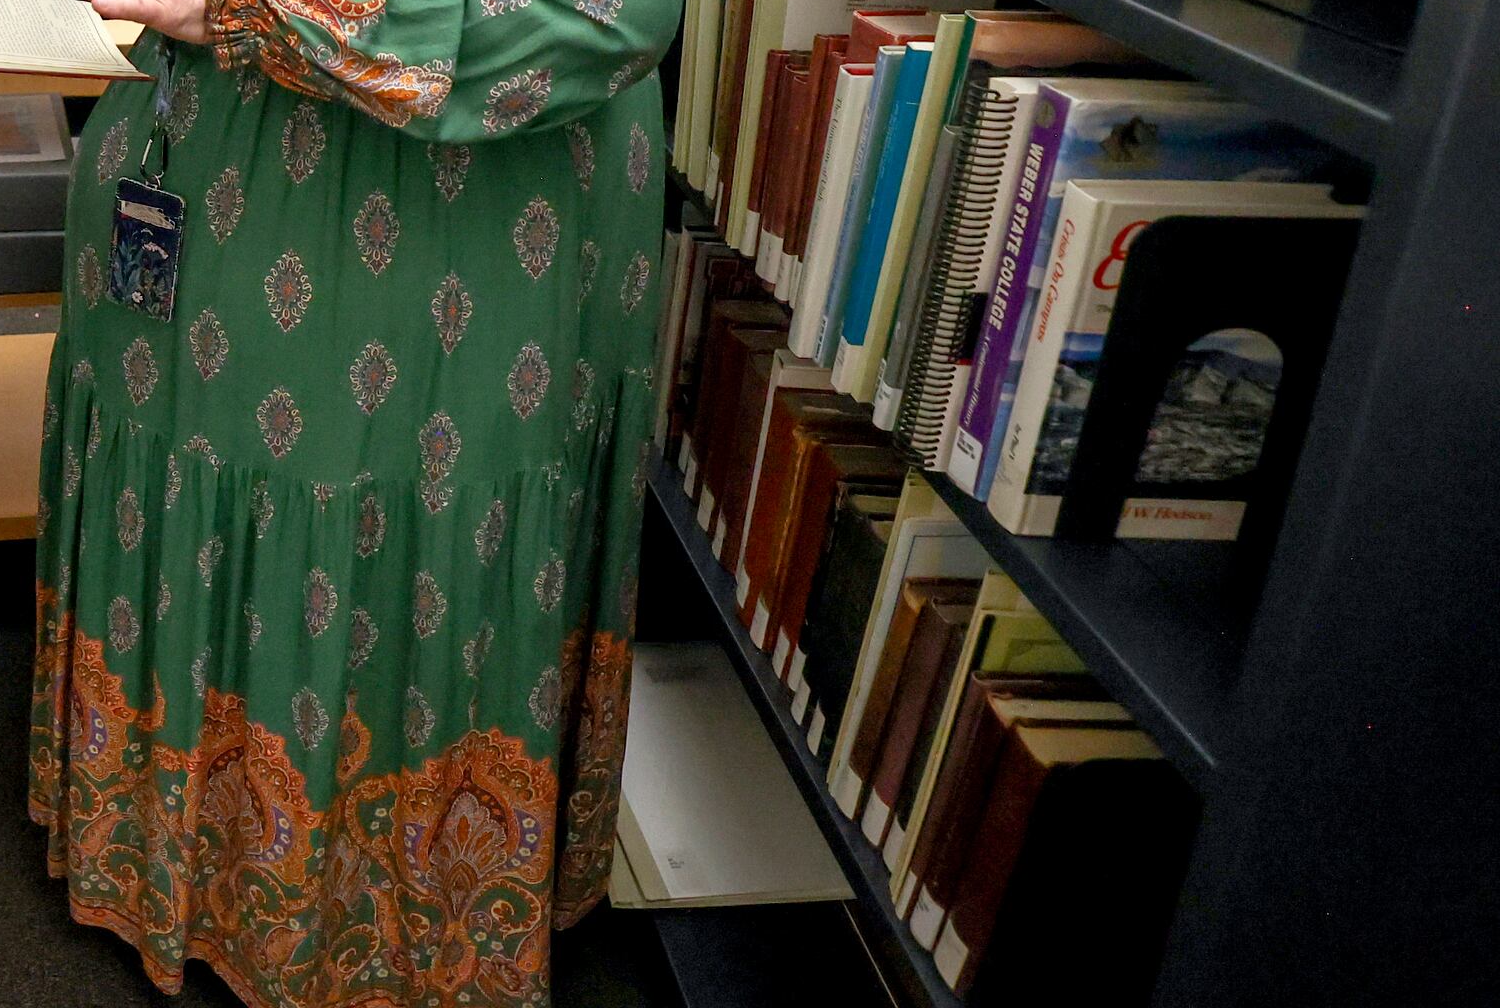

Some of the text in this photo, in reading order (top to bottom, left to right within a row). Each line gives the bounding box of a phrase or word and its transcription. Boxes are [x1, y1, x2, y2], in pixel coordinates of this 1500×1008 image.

[826, 117, 840, 162] University
[988, 143, 1044, 332] WEBER STATE COLLEGE
[1037, 218, 1076, 343] Crisis On Campus
[962, 390, 980, 429] History
